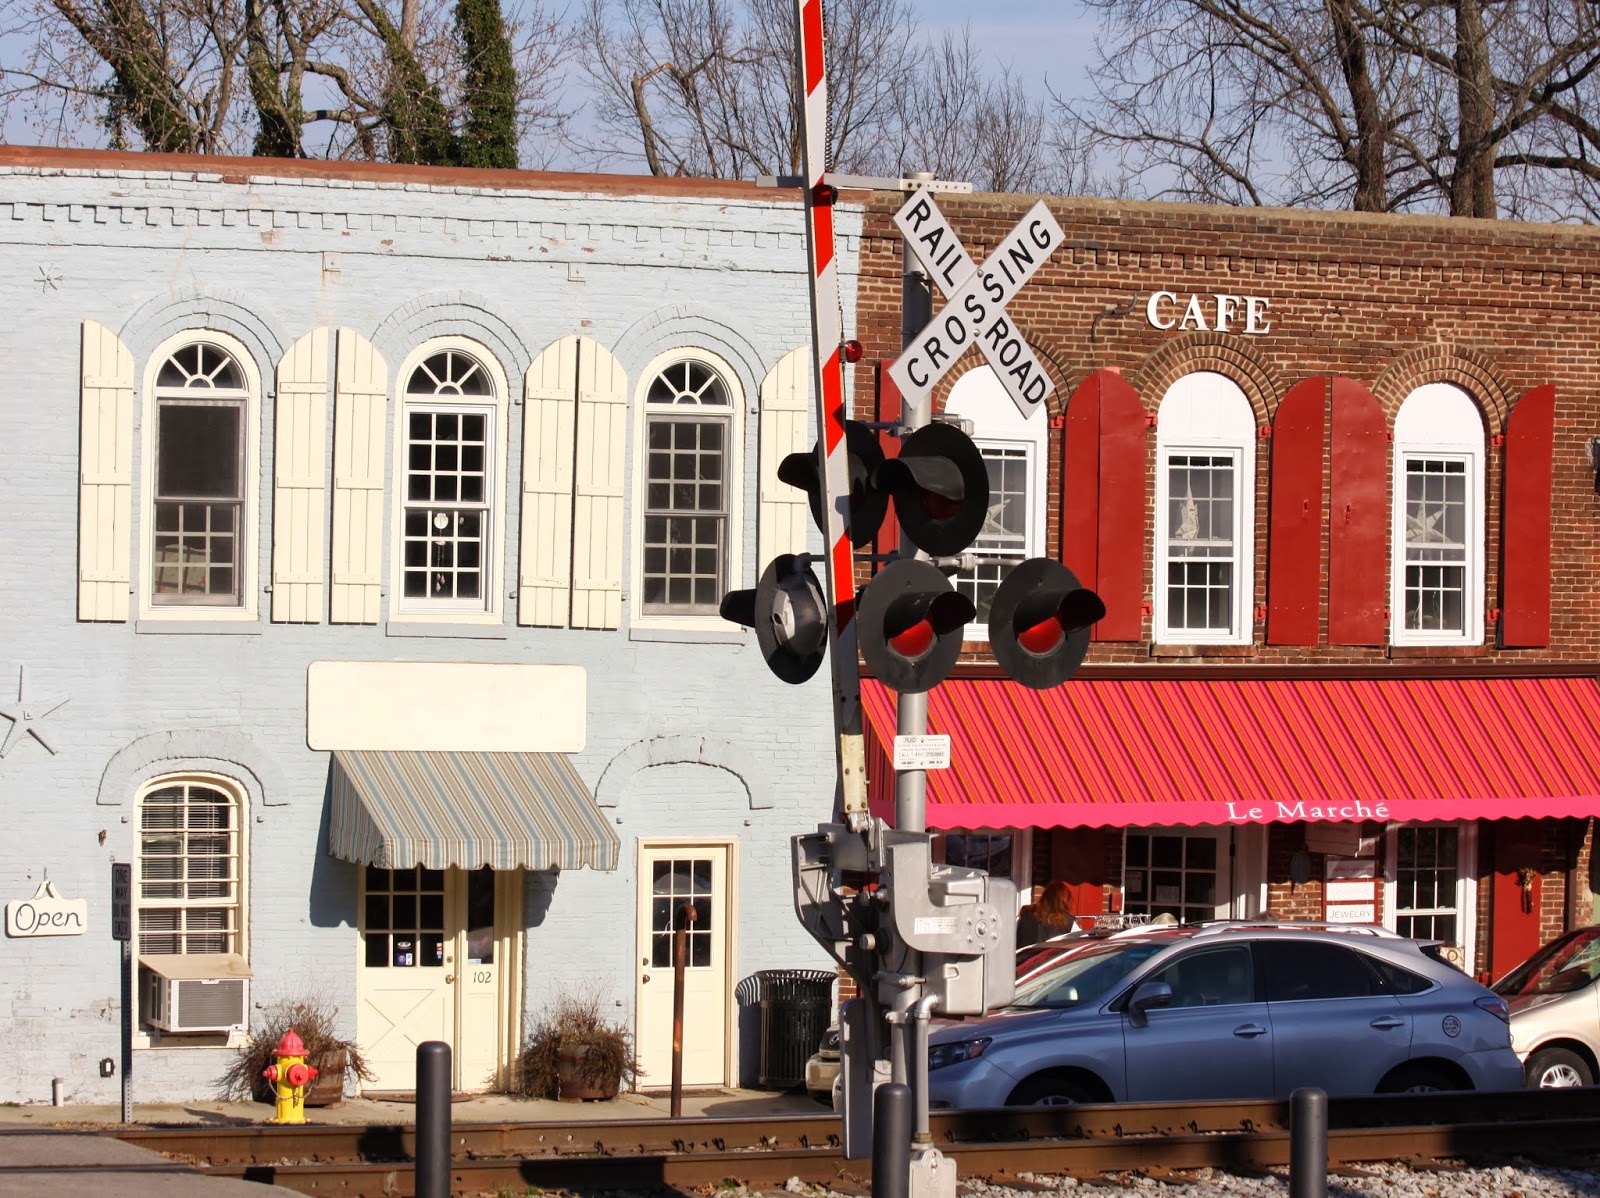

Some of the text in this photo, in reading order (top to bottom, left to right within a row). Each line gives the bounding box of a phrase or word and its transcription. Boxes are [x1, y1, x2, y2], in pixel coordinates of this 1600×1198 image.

[906, 198, 964, 288] RAIL
[907, 220, 1052, 388] CROSSING
[1146, 290, 1272, 335] CAFE
[985, 317, 1047, 405] ROAD
[1225, 800, 1390, 820] Le Marché
[115, 869, 128, 883] ONE
[115, 886, 128, 899] WAY
[15, 903, 83, 934] Open
[113, 903, 130, 917] DO NOT
[1329, 910, 1371, 919] JEWELRY
[115, 921, 128, 936] ENTER
[473, 971, 492, 984] 102
